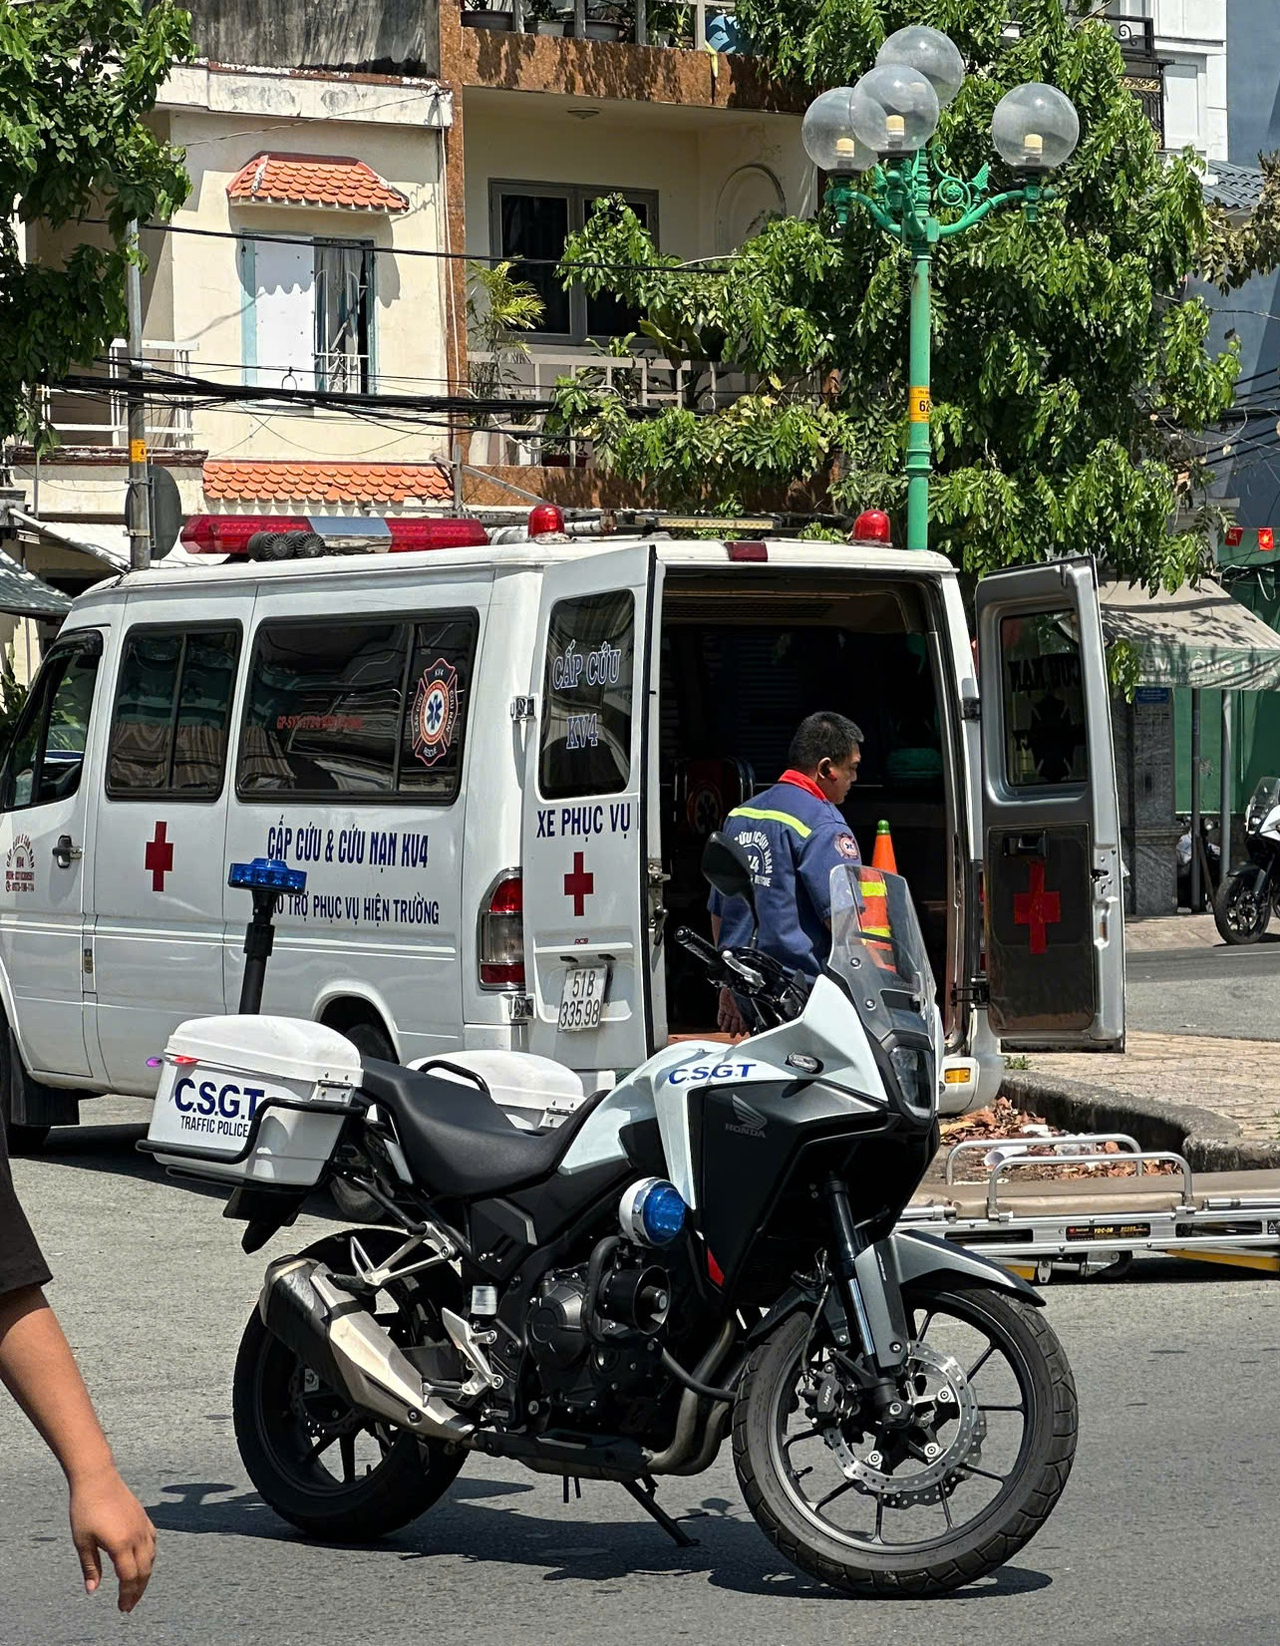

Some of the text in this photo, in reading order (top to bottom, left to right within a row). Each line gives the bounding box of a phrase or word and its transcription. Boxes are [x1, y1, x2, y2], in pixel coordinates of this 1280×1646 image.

[553, 638, 621, 690] CẤP CỨU
[566, 713, 599, 750] KV4
[537, 803, 631, 843] XE PHỤC VỤ
[268, 814, 429, 873] CẤP CỨU & CỨU NẠN KV4
[288, 891, 310, 922] TRỢ
[313, 895, 342, 924] PHỤC
[345, 896, 360, 925] VỤ
[364, 893, 390, 927] HIỆN
[393, 892, 440, 925] TRƯỜNG
[572, 970, 596, 998] 51B
[560, 998, 600, 1028] 335.98
[181, 1115, 249, 1138] TRAFFIC POLICE
[725, 1122, 767, 1138] HONDA
